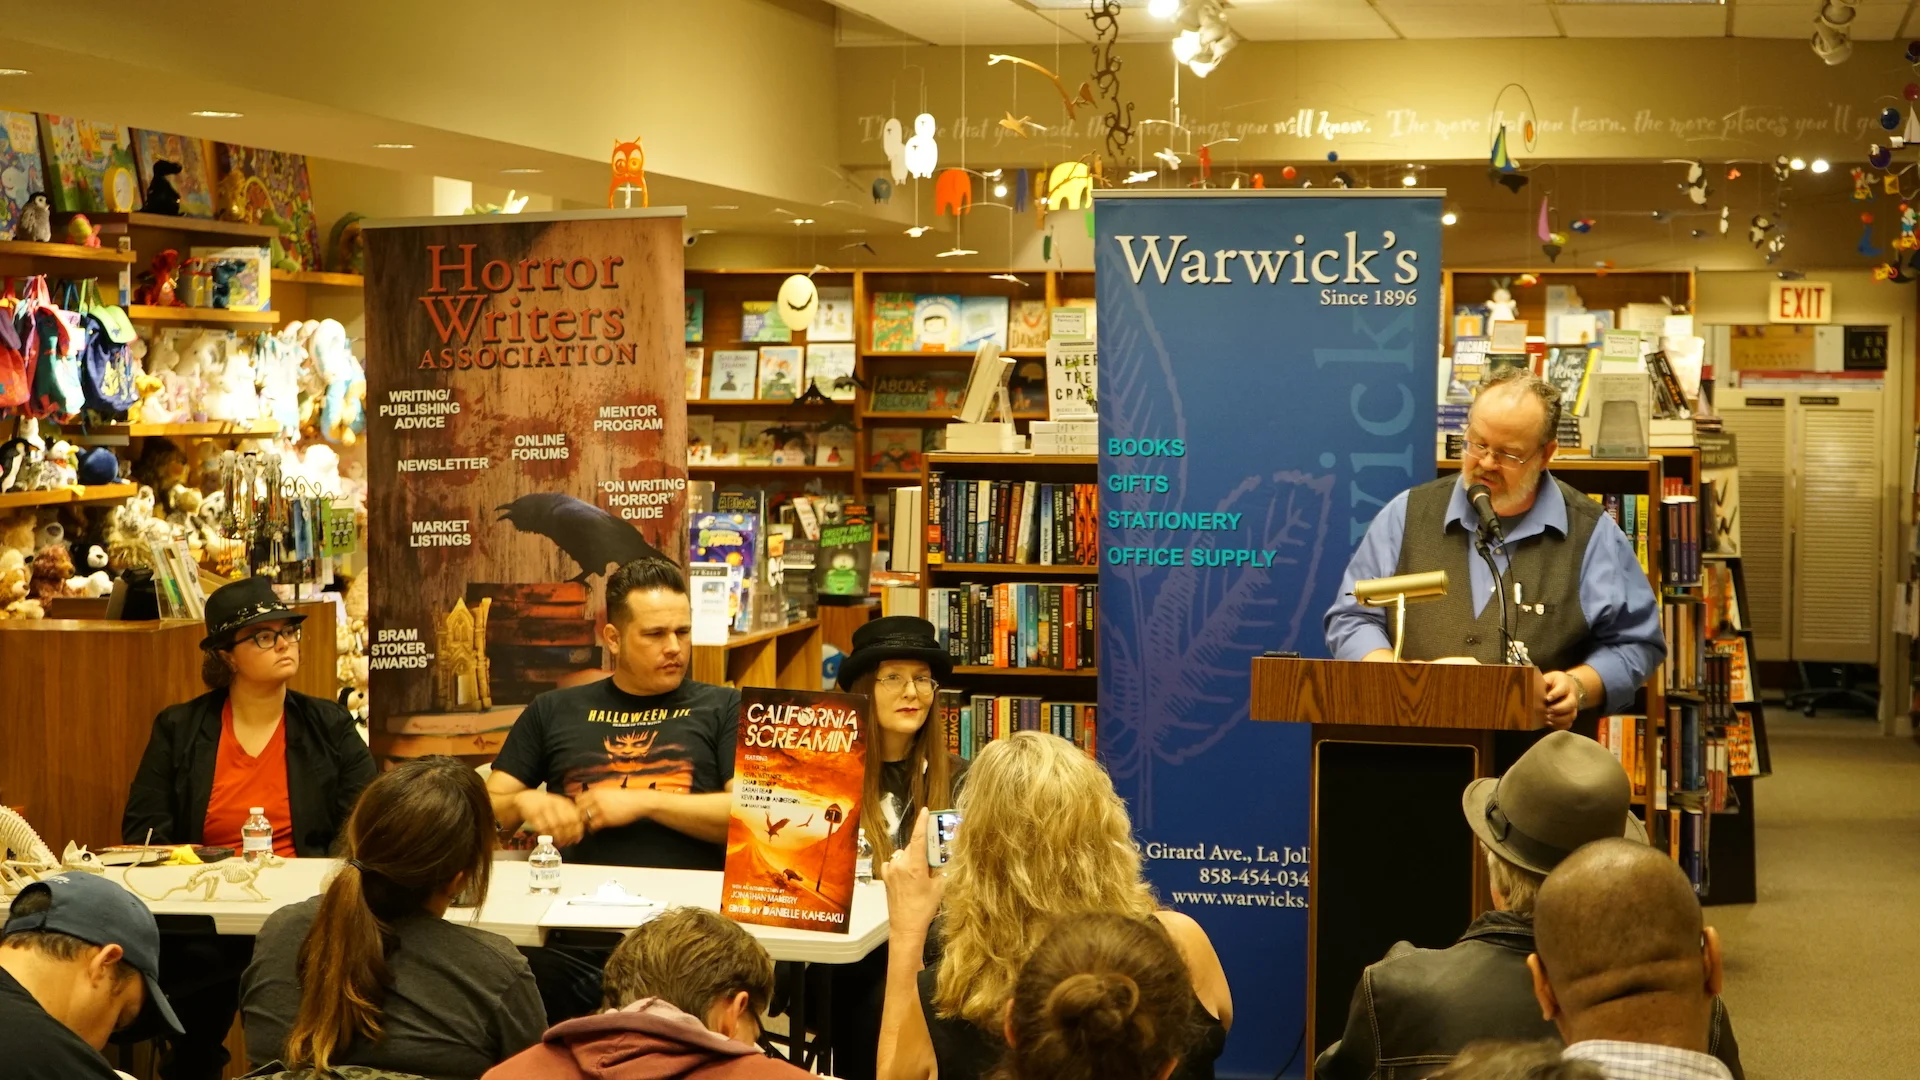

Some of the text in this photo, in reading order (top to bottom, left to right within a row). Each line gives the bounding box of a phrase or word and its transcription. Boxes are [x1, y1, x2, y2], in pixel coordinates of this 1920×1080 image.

[1273, 108, 1313, 138] will
[1314, 108, 1370, 141] know.
[1386, 109, 1431, 138] The
[1433, 117, 1480, 140] more
[1632, 108, 1663, 138] the
[1717, 104, 1787, 141] places
[1115, 230, 1421, 285] Warwick's
[426, 244, 624, 293] Horror
[1320, 289, 1418, 306] Since 1896
[1780, 287, 1825, 319] EXIT
[419, 294, 625, 344] Writers
[418, 343, 638, 370] ASSOCIATION
[1065, 371, 1092, 384] THE
[389, 389, 450, 402] WRITING/
[379, 402, 461, 417] PUBLISHING
[599, 405, 657, 418] MENTOR
[394, 416, 445, 430] ADVICE
[593, 418, 663, 432] PROGRAM
[515, 434, 565, 447] ONLINE
[1108, 438, 1186, 458] BOOKS
[511, 447, 569, 461] FORUMS
[398, 457, 489, 472] NEWSLETTER
[627, 478, 686, 492] WRITING
[1108, 474, 1170, 494] GIFTS
[621, 506, 664, 520] GUIDE
[1107, 510, 1242, 531] STATIONERY
[412, 520, 469, 533] MARKET
[410, 533, 472, 547] LISTINGS
[1107, 547, 1277, 568] OFFICE SUPPLY
[378, 629, 418, 642] BRAM
[371, 642, 426, 655] STOKER
[588, 707, 669, 723] HALLOWEEN
[747, 703, 858, 730] CALIFORNIA
[949, 707, 959, 746] TOWER
[744, 724, 859, 753] SCREAMIN'
[772, 797, 801, 805] ANDERSON
[1146, 843, 1310, 866] Girard Ave., La Jol
[1199, 868, 1310, 888] 858-454-034
[731, 890, 798, 904] JONATHAN MABERRY
[1172, 890, 1310, 909] www.warwicks.
[728, 904, 845, 924] EDITED BY DANIELLE KAHEAKU
